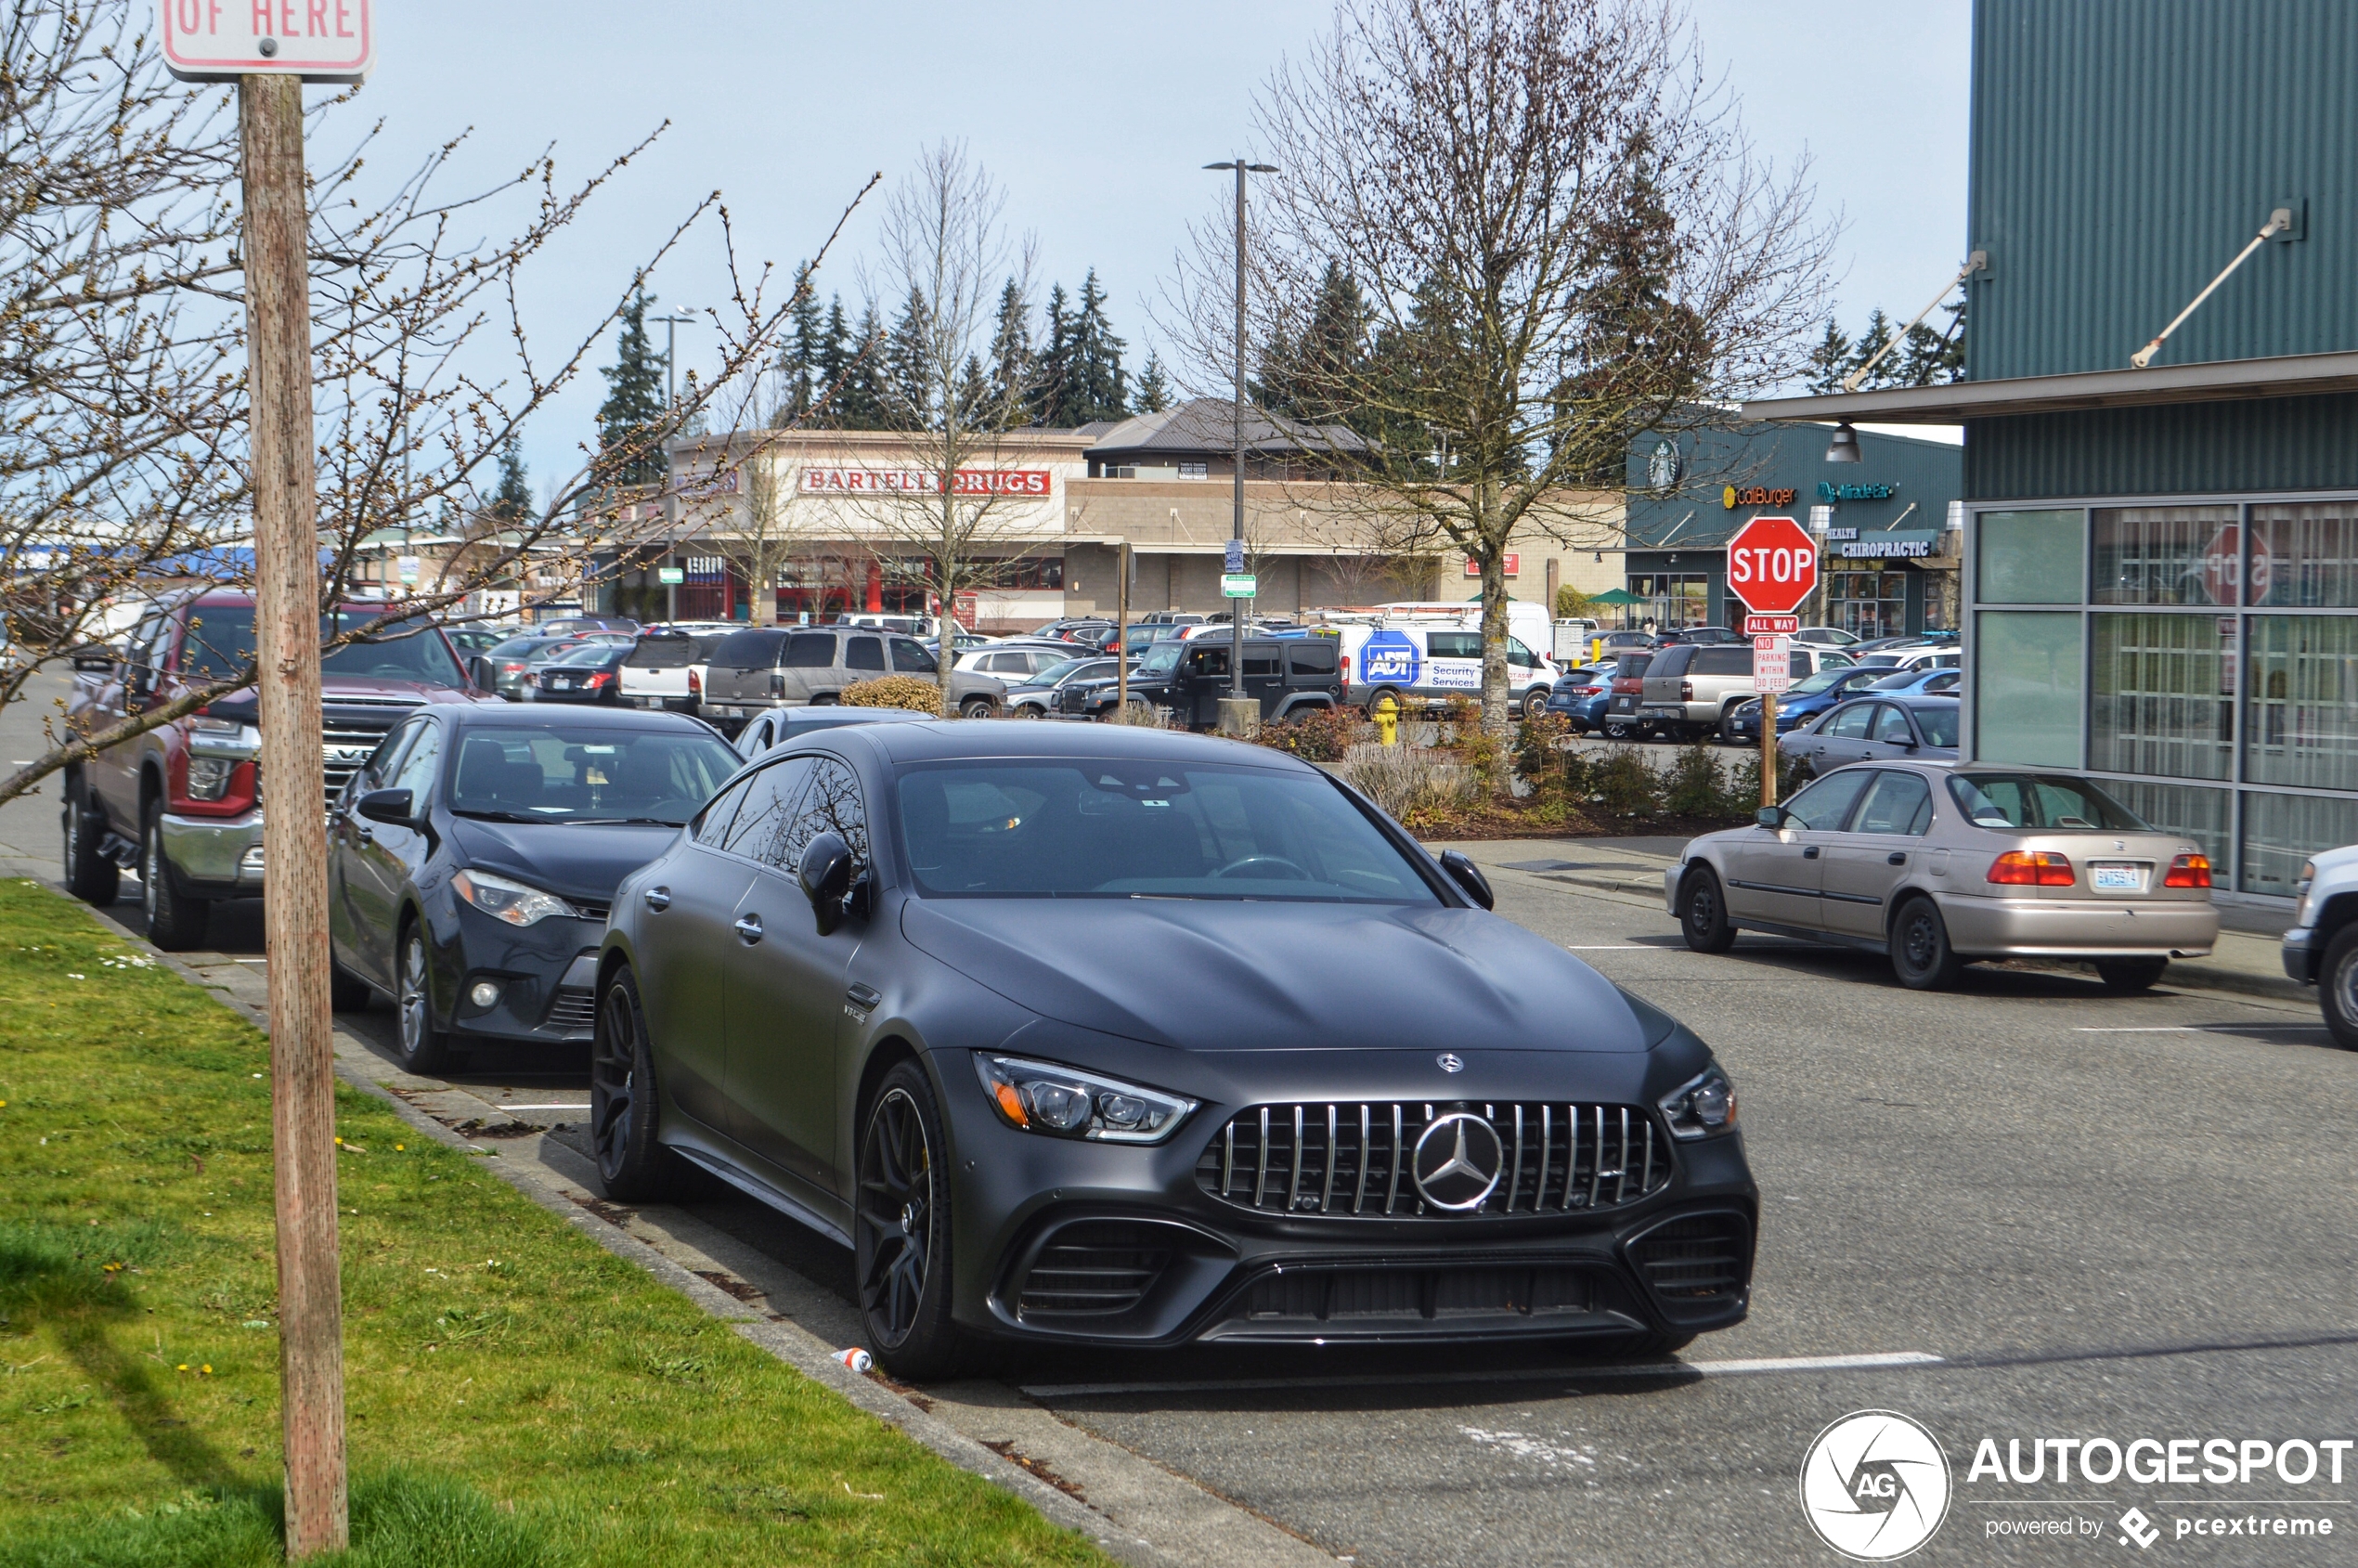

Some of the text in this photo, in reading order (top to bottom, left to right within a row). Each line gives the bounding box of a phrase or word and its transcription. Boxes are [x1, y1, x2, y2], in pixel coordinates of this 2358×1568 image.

[178, 0, 355, 37] OF HERE
[809, 471, 1044, 492] BARTELL DRUGS
[1737, 486, 1794, 508] CaliBurger
[1826, 527, 1857, 539] HEALTH
[1841, 541, 1929, 558] CHIROPRACTIC
[1733, 548, 1813, 583] STOP
[1750, 619, 1794, 630] ALL WAY
[1757, 638, 1771, 649] NO
[1369, 651, 1410, 676] ADT
[1757, 654, 1786, 662] PARKING
[1433, 666, 1475, 679] Security
[1760, 666, 1784, 674] WITHIN
[1432, 677, 1475, 687] Services
[1757, 678, 1786, 687] 30 FEET
